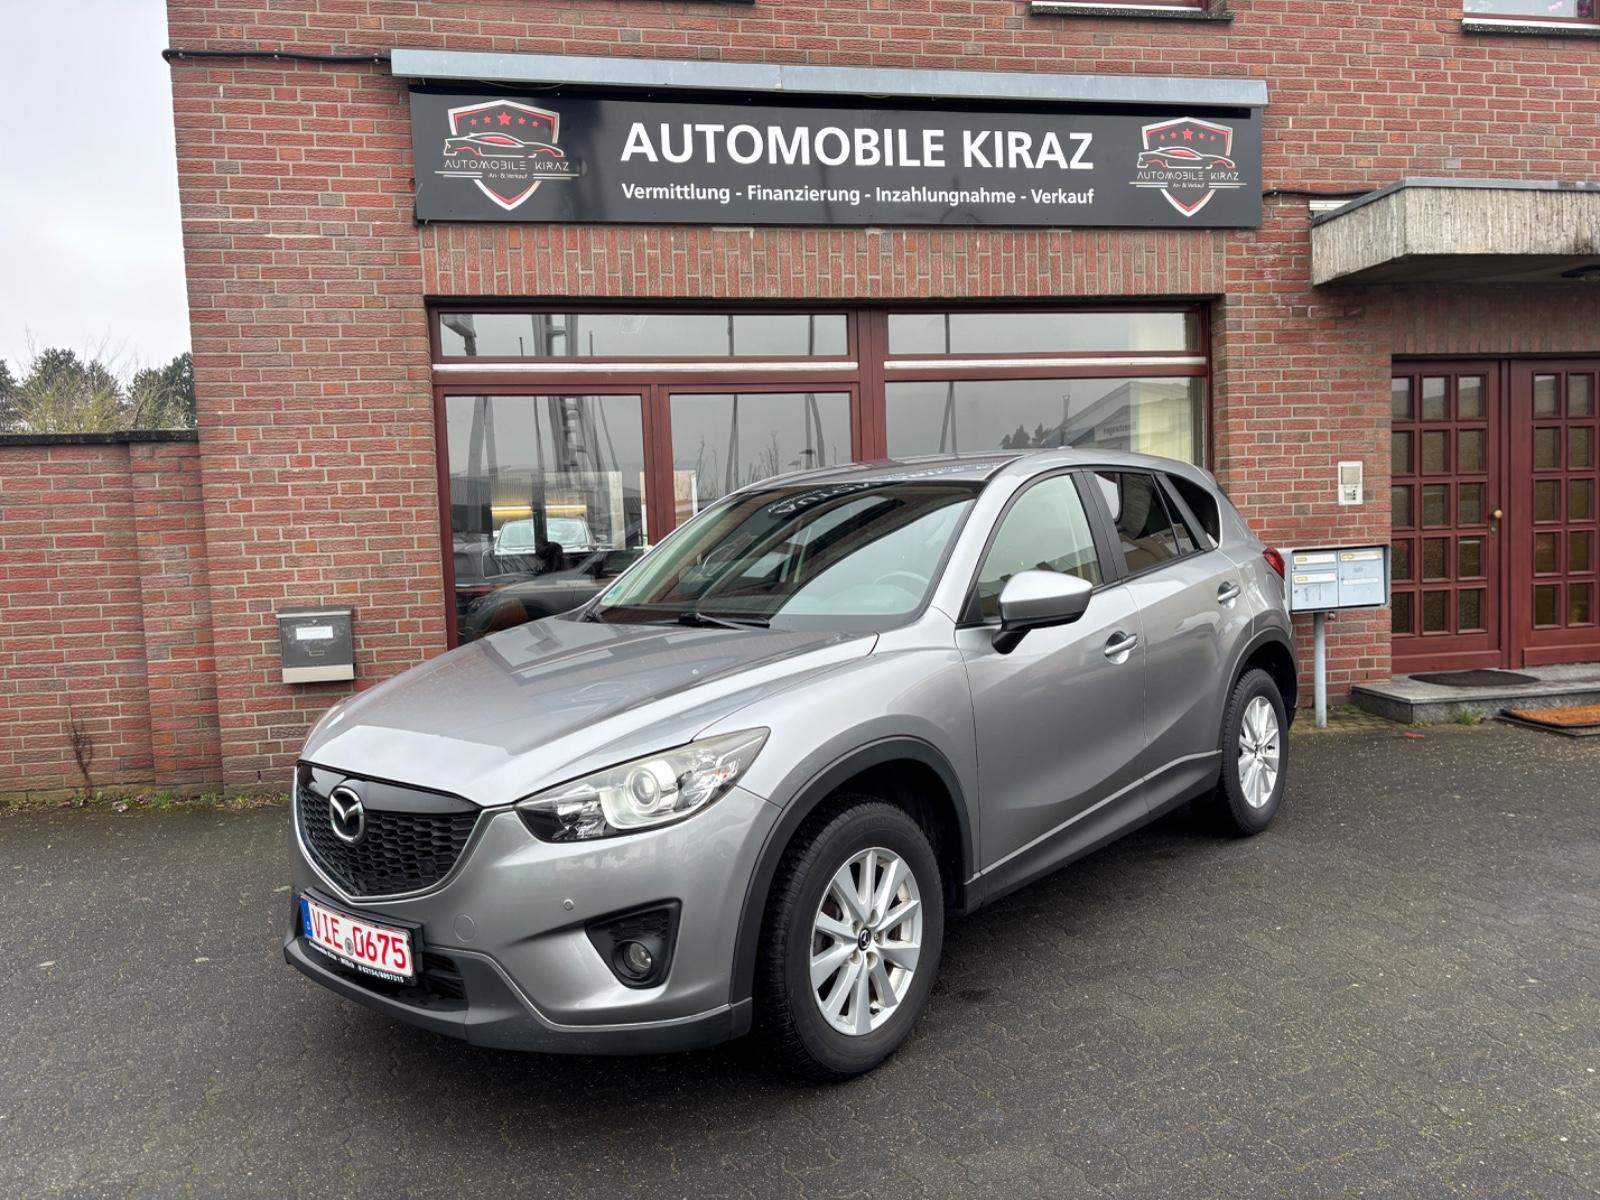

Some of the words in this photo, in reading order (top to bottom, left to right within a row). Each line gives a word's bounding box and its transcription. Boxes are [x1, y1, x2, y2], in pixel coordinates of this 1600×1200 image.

[620, 121, 946, 167] AUTOMOBILE
[962, 130, 1094, 170] KIRAZ
[444, 159, 527, 170] AUTOMOBILE
[535, 161, 570, 171] KIRAZ
[1136, 170, 1205, 181] AUTOMOBILE
[1210, 172, 1239, 181] KIRAZ
[621, 182, 731, 205] Vermittlung
[747, 184, 861, 206] Finanzierung
[876, 186, 1016, 207] Inzahlungnahme
[1031, 188, 1095, 205] Verkauf
[311, 908, 343, 950] VIE
[352, 925, 407, 969] 0675
